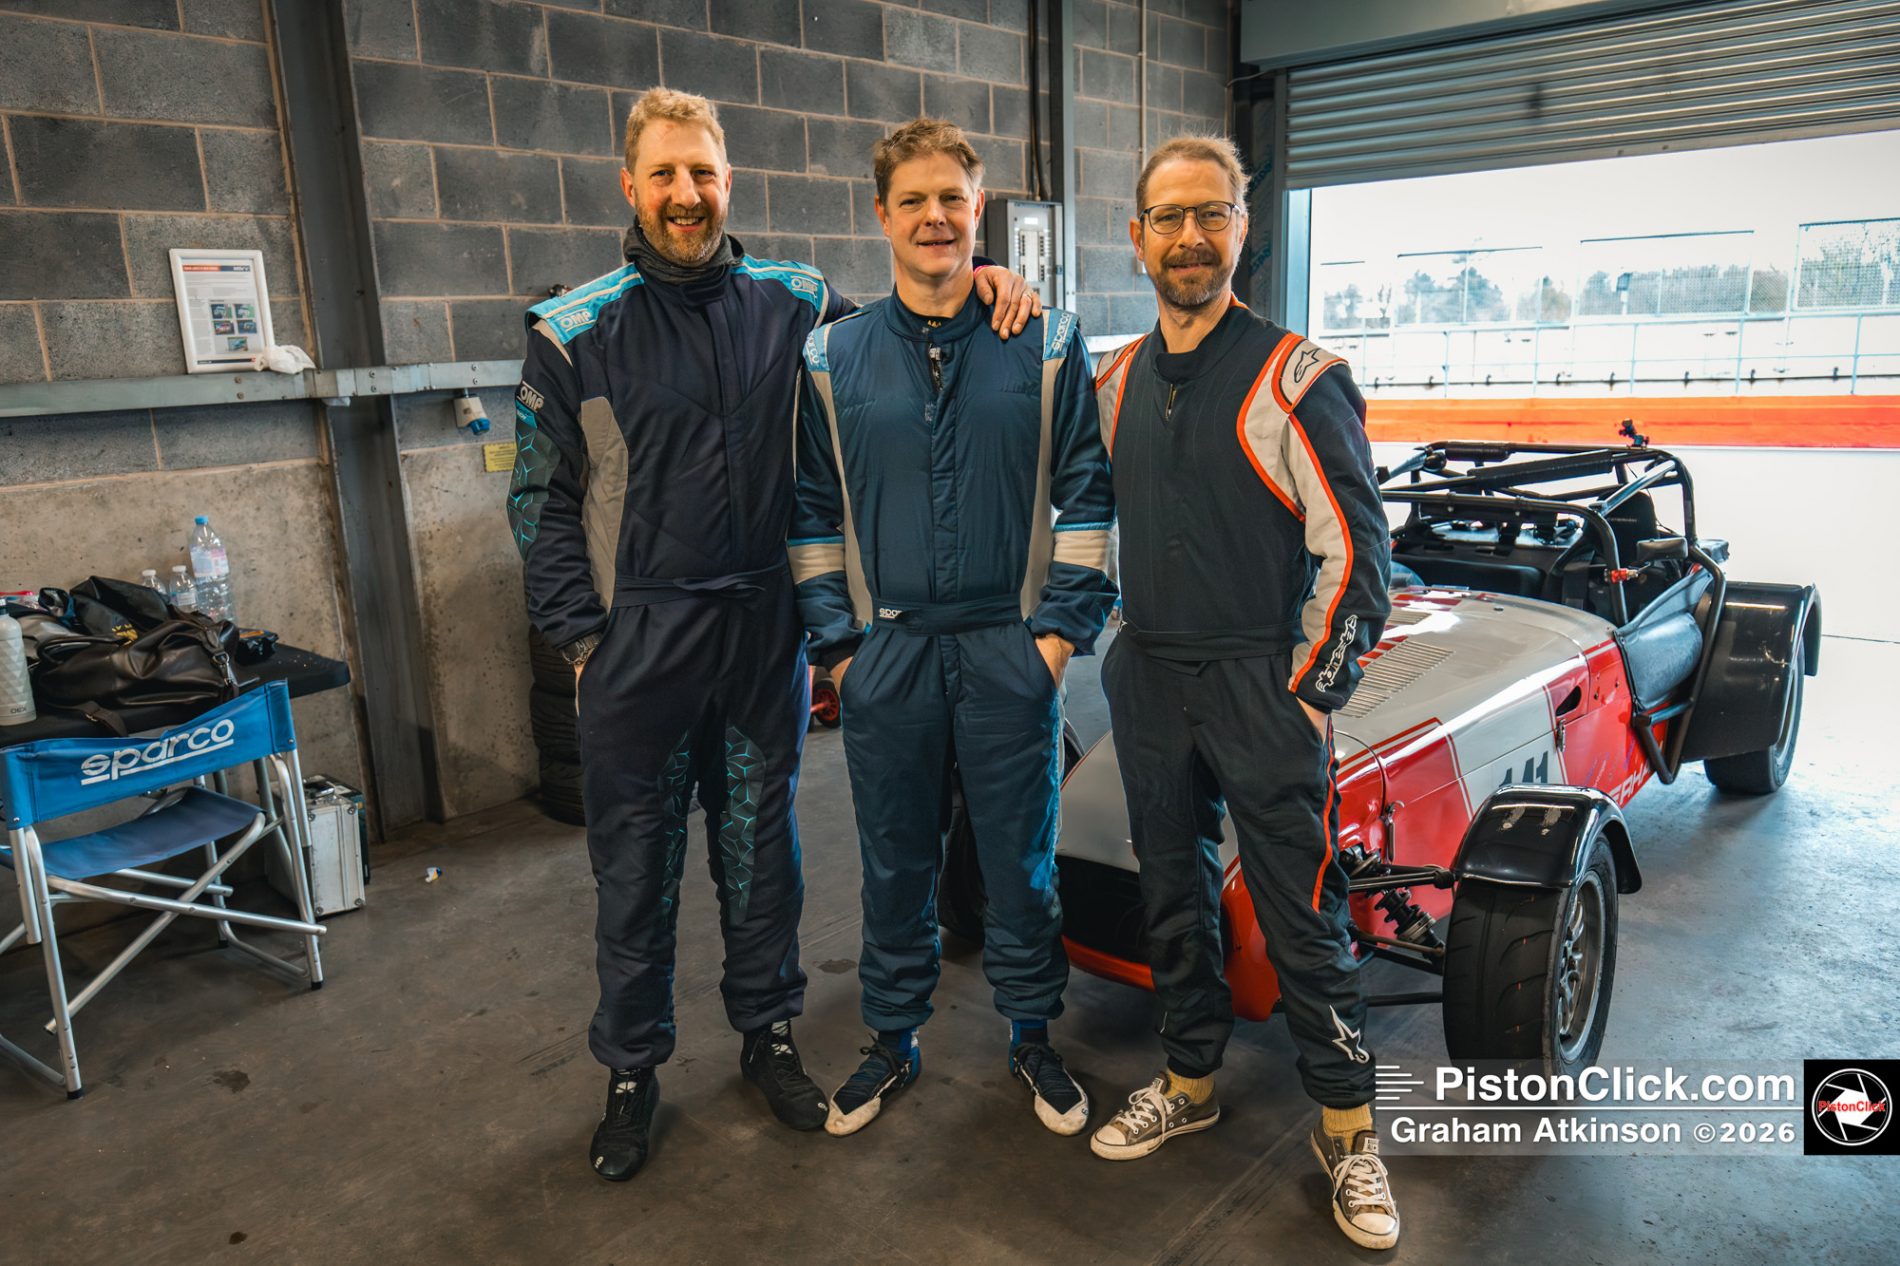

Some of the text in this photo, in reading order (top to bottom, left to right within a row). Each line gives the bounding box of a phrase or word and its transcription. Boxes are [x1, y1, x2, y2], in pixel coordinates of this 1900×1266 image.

[790, 277, 818, 293] OMP
[559, 310, 593, 331] OMP
[1051, 312, 1072, 352] sparco
[519, 384, 545, 412] OMP
[81, 719, 234, 785] sparco
